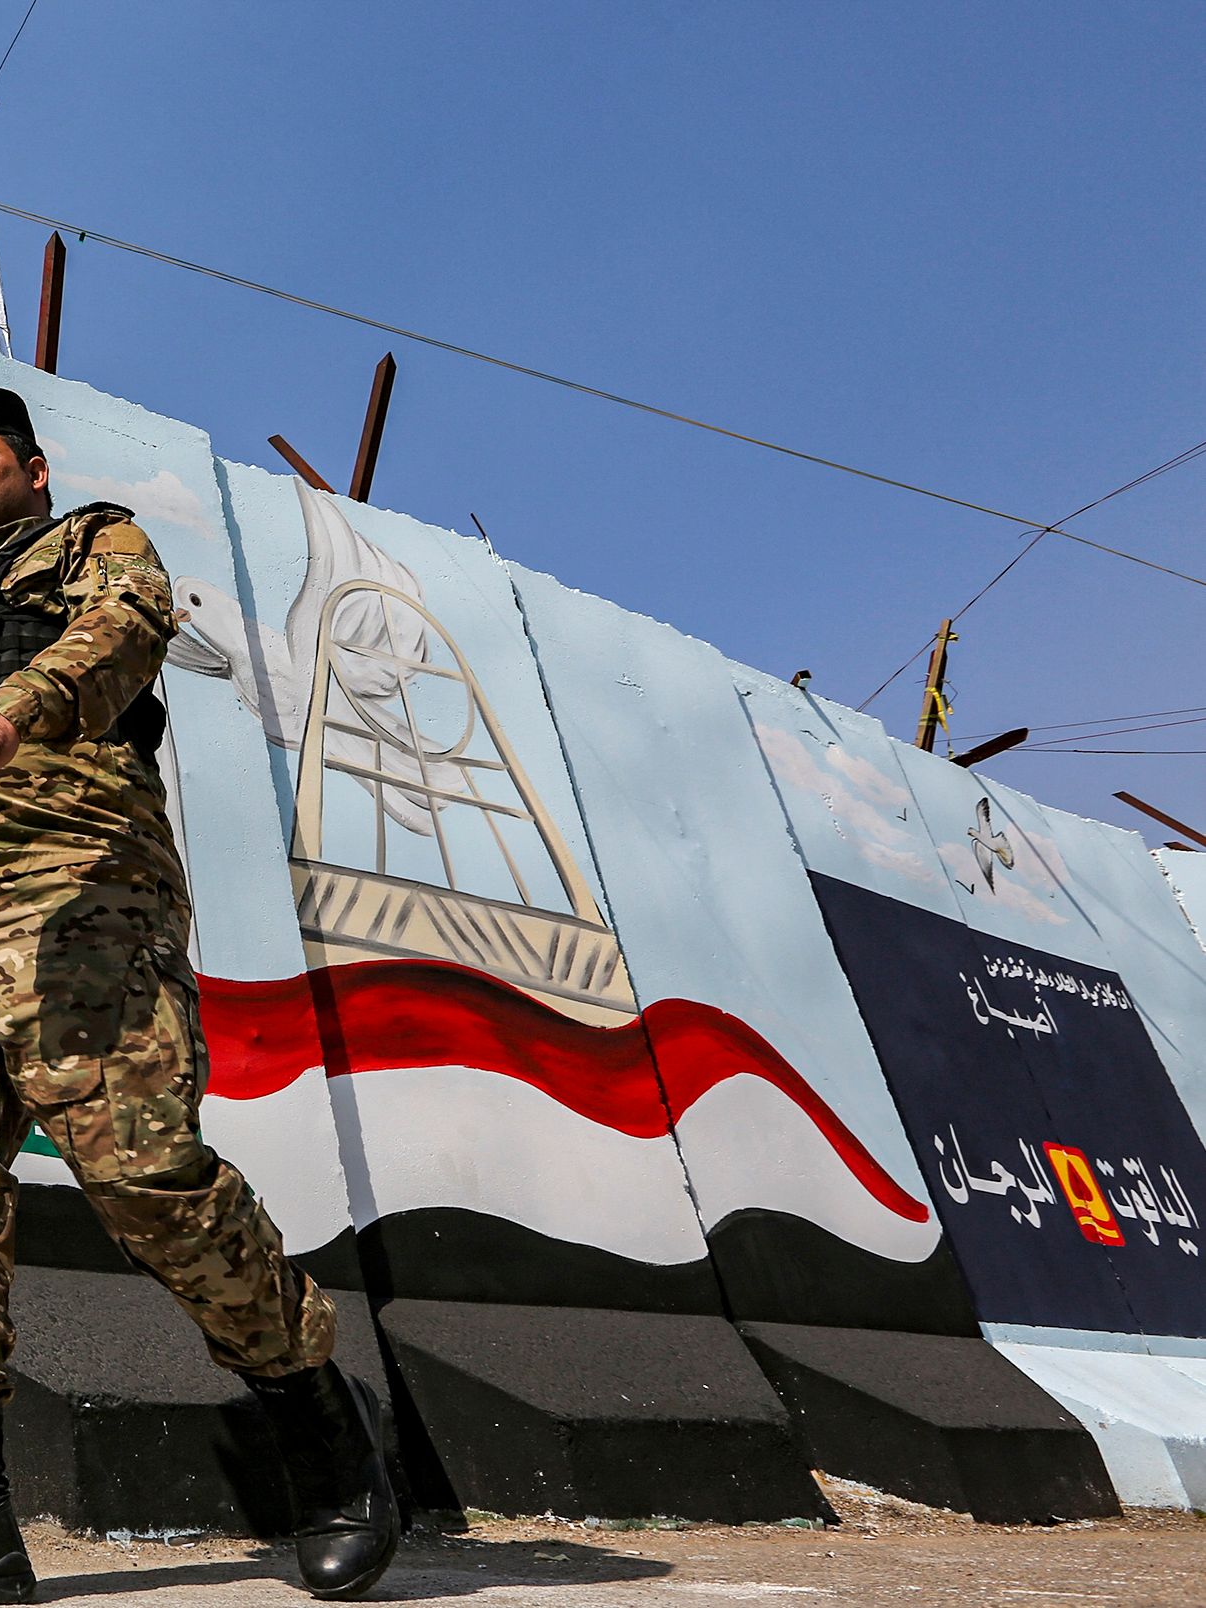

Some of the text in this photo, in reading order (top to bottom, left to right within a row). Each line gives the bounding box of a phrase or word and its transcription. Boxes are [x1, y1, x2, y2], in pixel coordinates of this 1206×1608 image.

[958, 971, 1059, 1041] أصباغ
[933, 1122, 1201, 1258] الياقوت المرجان
